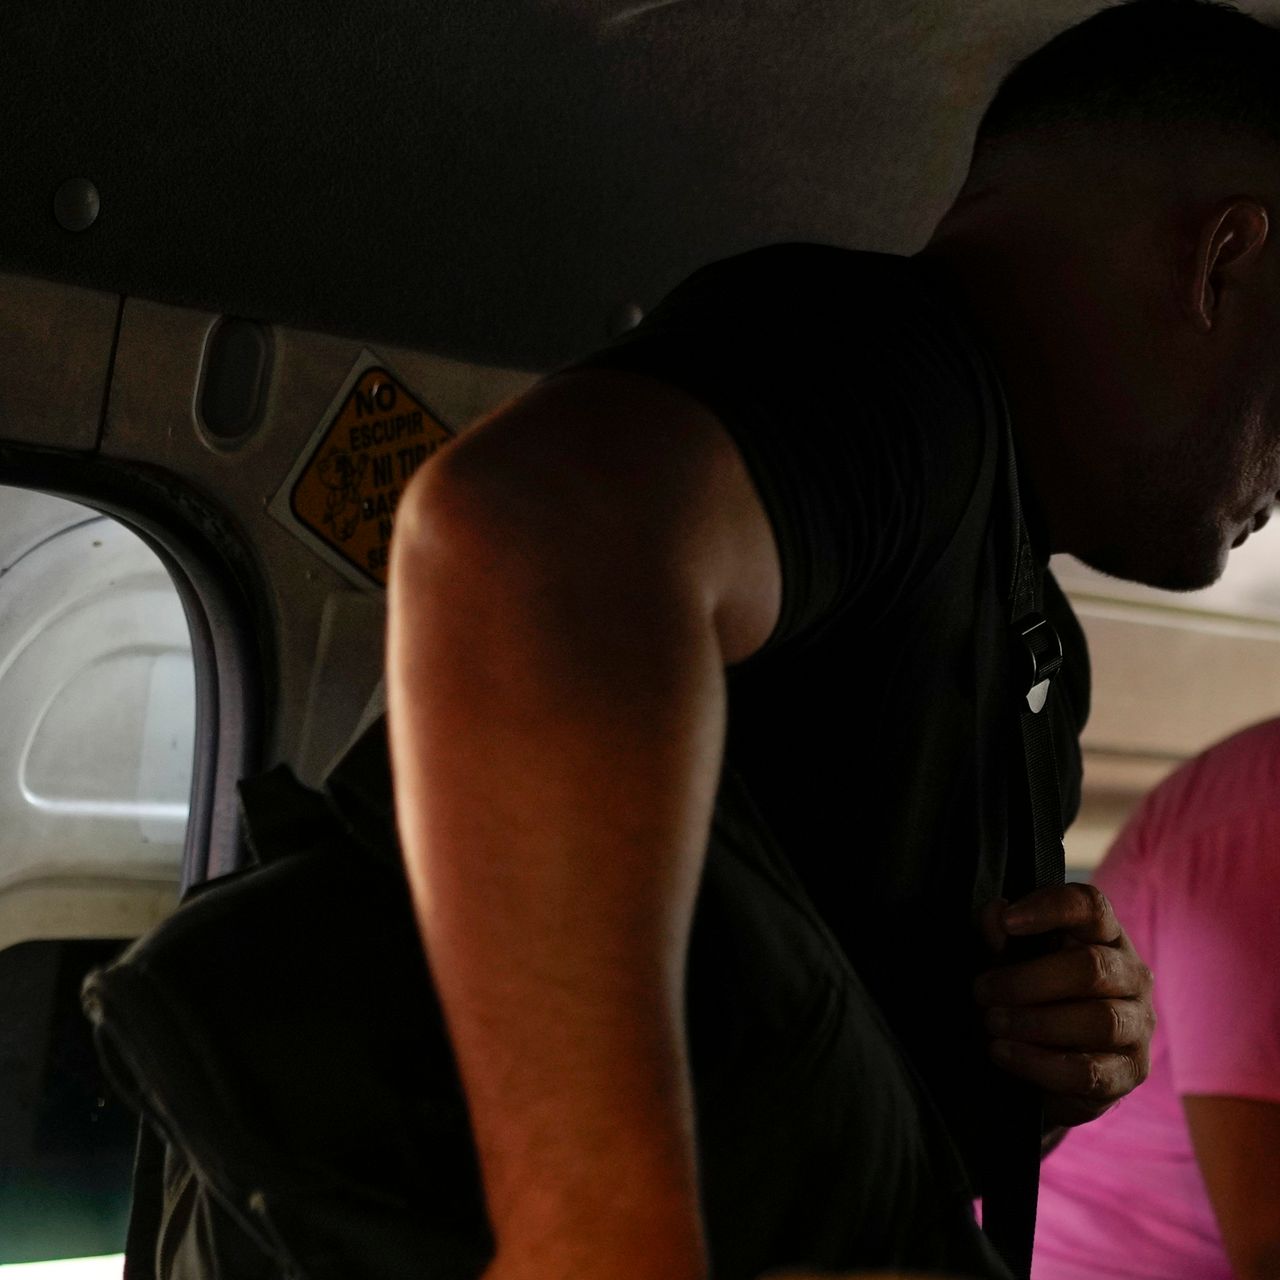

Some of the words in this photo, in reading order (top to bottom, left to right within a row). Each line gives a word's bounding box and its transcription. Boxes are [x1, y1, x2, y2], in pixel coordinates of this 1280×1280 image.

[354, 382, 396, 417] NO
[350, 411, 423, 452] ESCUPIR
[374, 452, 393, 488] NI
